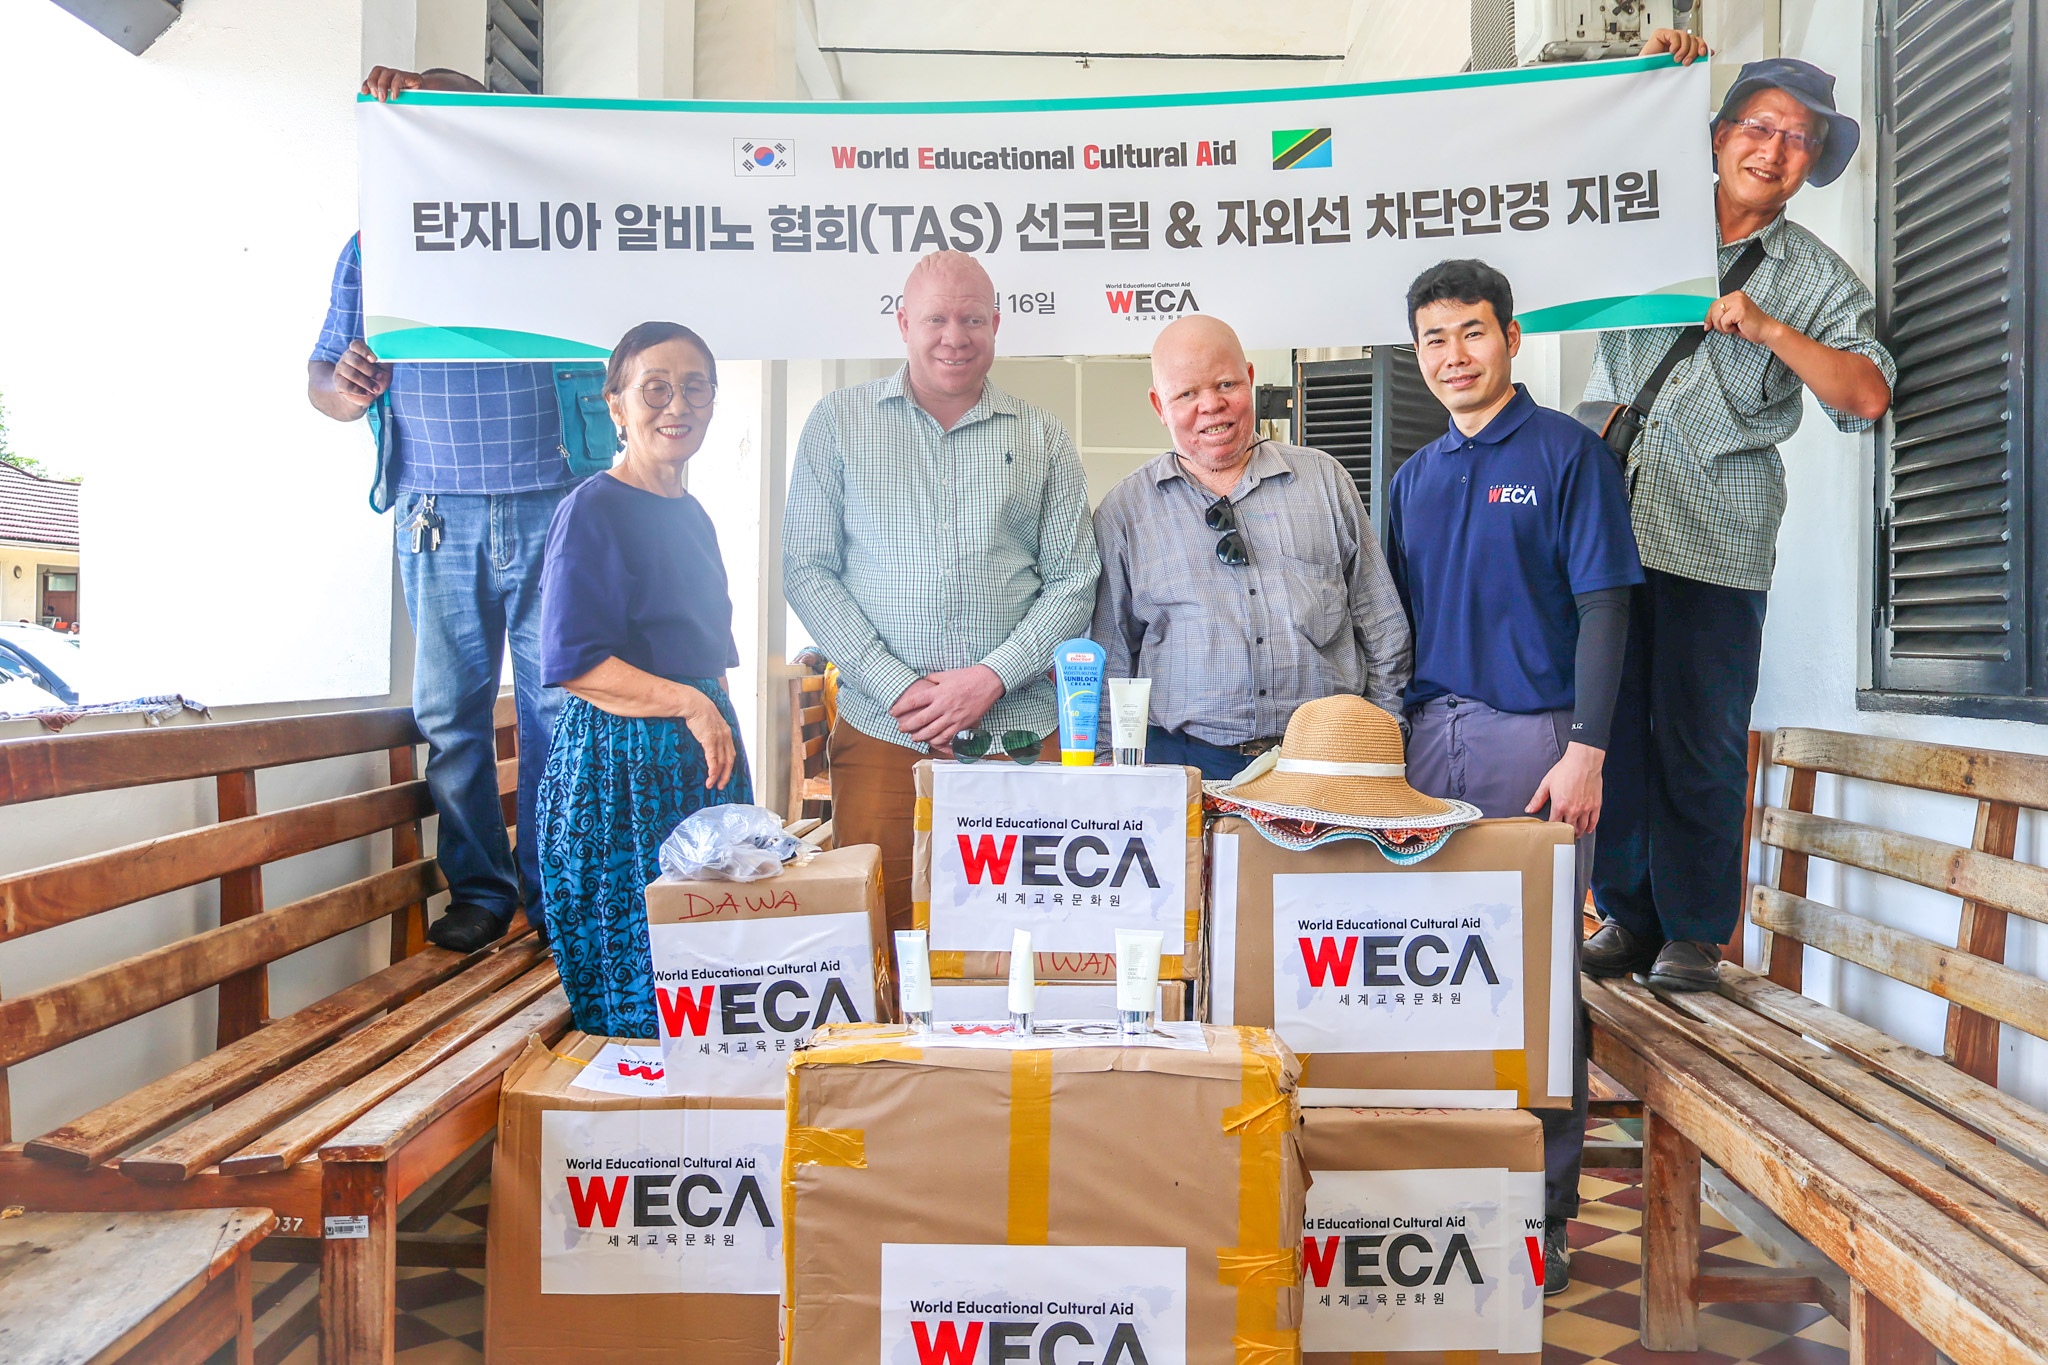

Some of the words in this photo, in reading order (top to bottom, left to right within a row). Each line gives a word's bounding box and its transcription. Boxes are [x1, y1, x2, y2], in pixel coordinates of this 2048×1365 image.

[831, 145, 909, 169] World
[918, 145, 1075, 170] Educational
[1083, 141, 1188, 170] Cultural
[1196, 139, 1237, 167] Aid
[412, 201, 602, 252] 탄자니아
[614, 204, 755, 252] 알비노
[767, 201, 1003, 255] 협회(TAS)
[1016, 200, 1150, 253] 선크림
[1164, 199, 1202, 249] &
[1216, 196, 1351, 248] 자외선
[1367, 181, 1550, 241] 차단안경
[1566, 169, 1660, 225] 지원
[1008, 291, 1056, 315] 16일
[1105, 289, 1200, 314] WECA
[1488, 487, 1538, 506] WECA
[957, 816, 993, 828] World
[996, 817, 1068, 830] Educational
[1071, 818, 1120, 831] Cultural
[1122, 820, 1143, 831] Aid
[956, 833, 1161, 888] WECA
[678, 890, 801, 920] DAWA
[995, 892, 1121, 907] 세계교육문화원
[1298, 919, 1333, 931] World
[1336, 918, 1407, 930] Educational
[1410, 917, 1458, 929] Cultural
[1461, 917, 1481, 929] Aid
[653, 969, 688, 982] World
[691, 965, 764, 981] Educational
[767, 962, 817, 976] Cultural
[820, 960, 841, 972] Aid
[1298, 934, 1500, 988] WECA
[655, 977, 862, 1038] WECA
[1339, 992, 1461, 1006] 세계교육문화원
[698, 1038, 805, 1055] 세계교육문화
[566, 1158, 602, 1170] World
[605, 1157, 680, 1170] Educational
[683, 1156, 732, 1169] Cultural
[735, 1157, 756, 1169] Aid
[566, 1173, 775, 1228] WECA
[1317, 1217, 1390, 1230] Educational
[1392, 1216, 1443, 1229] Cultural
[1445, 1216, 1466, 1228] Aid
[607, 1233, 735, 1247] 세계교육문화원
[910, 1300, 953, 1314] World
[956, 1301, 1043, 1315] Educational
[1047, 1301, 1105, 1316] Cultural
[1109, 1302, 1134, 1316] Aid
[1319, 1292, 1445, 1307] 세계교육문화원
[910, 1320, 1150, 1365] WECA
